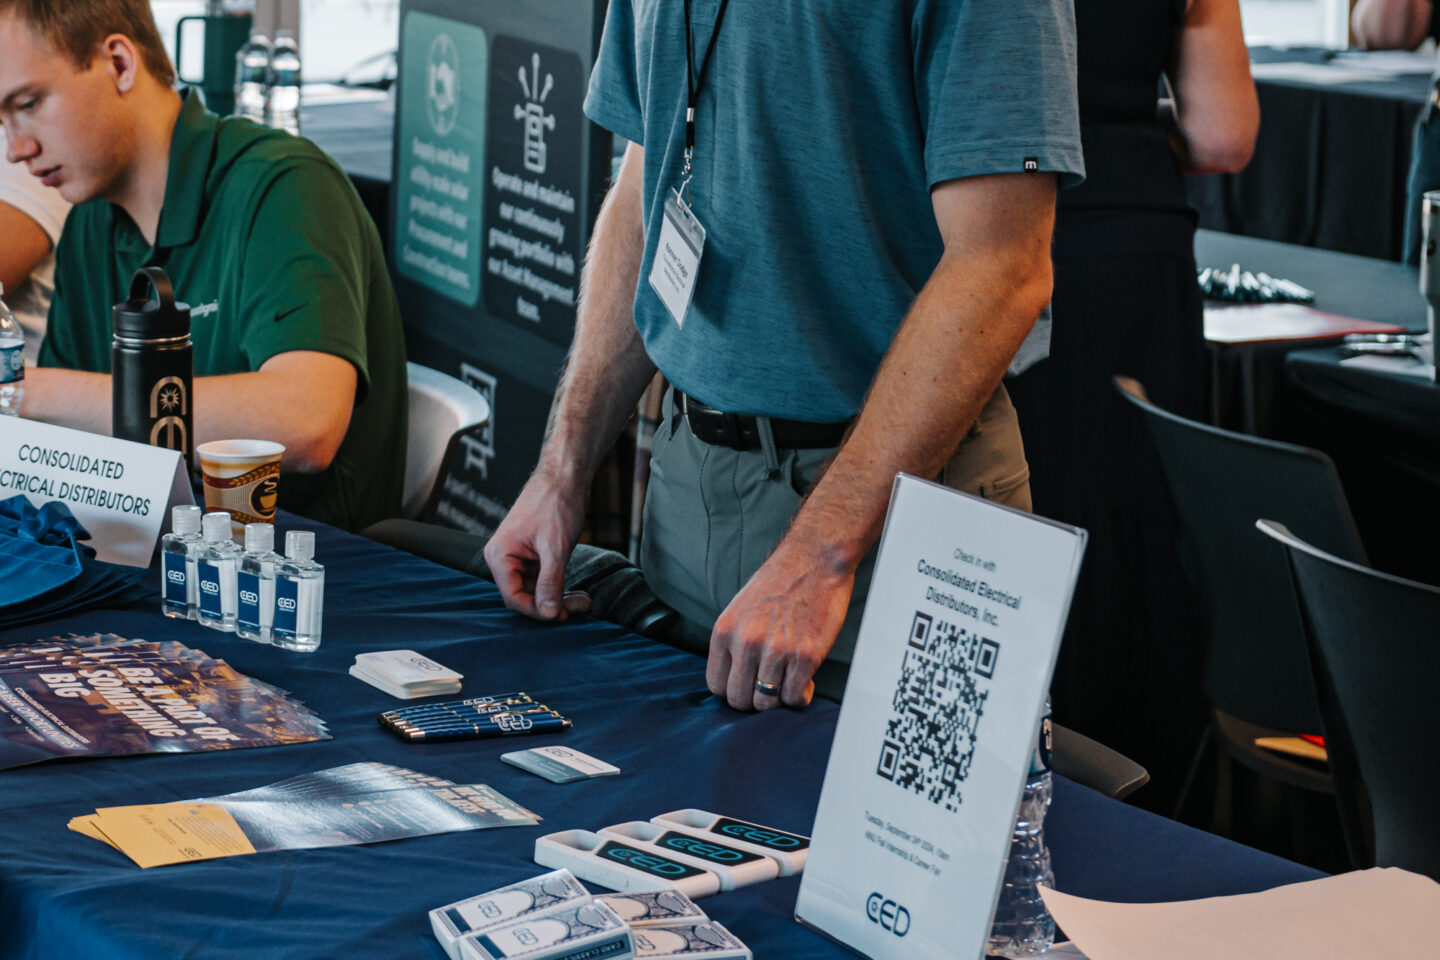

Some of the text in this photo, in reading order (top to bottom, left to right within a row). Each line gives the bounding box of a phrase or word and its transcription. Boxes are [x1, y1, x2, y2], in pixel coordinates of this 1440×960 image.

[18, 444, 124, 480] CONSOLIDATED
[58, 482, 151, 517] DISTRIBUTORS
[167, 570, 186, 582] CED
[200, 580, 219, 593] CED
[917, 558, 1022, 610] Consolidated Electrical
[240, 590, 258, 603] CED
[277, 597, 296, 610] CED
[926, 585, 999, 628] Distributors, Inc.
[38, 672, 92, 699] BIG
[79, 669, 187, 738] SOMETHING
[117, 667, 164, 685] BE
[152, 697, 218, 725] PART
[192, 726, 241, 741] OF
[498, 719, 533, 732] CED
[666, 836, 745, 862] CED
[721, 823, 801, 849] CED
[607, 847, 688, 876] CED
[477, 899, 503, 920] CED
[865, 891, 911, 938] CED
[511, 926, 540, 946] CED
